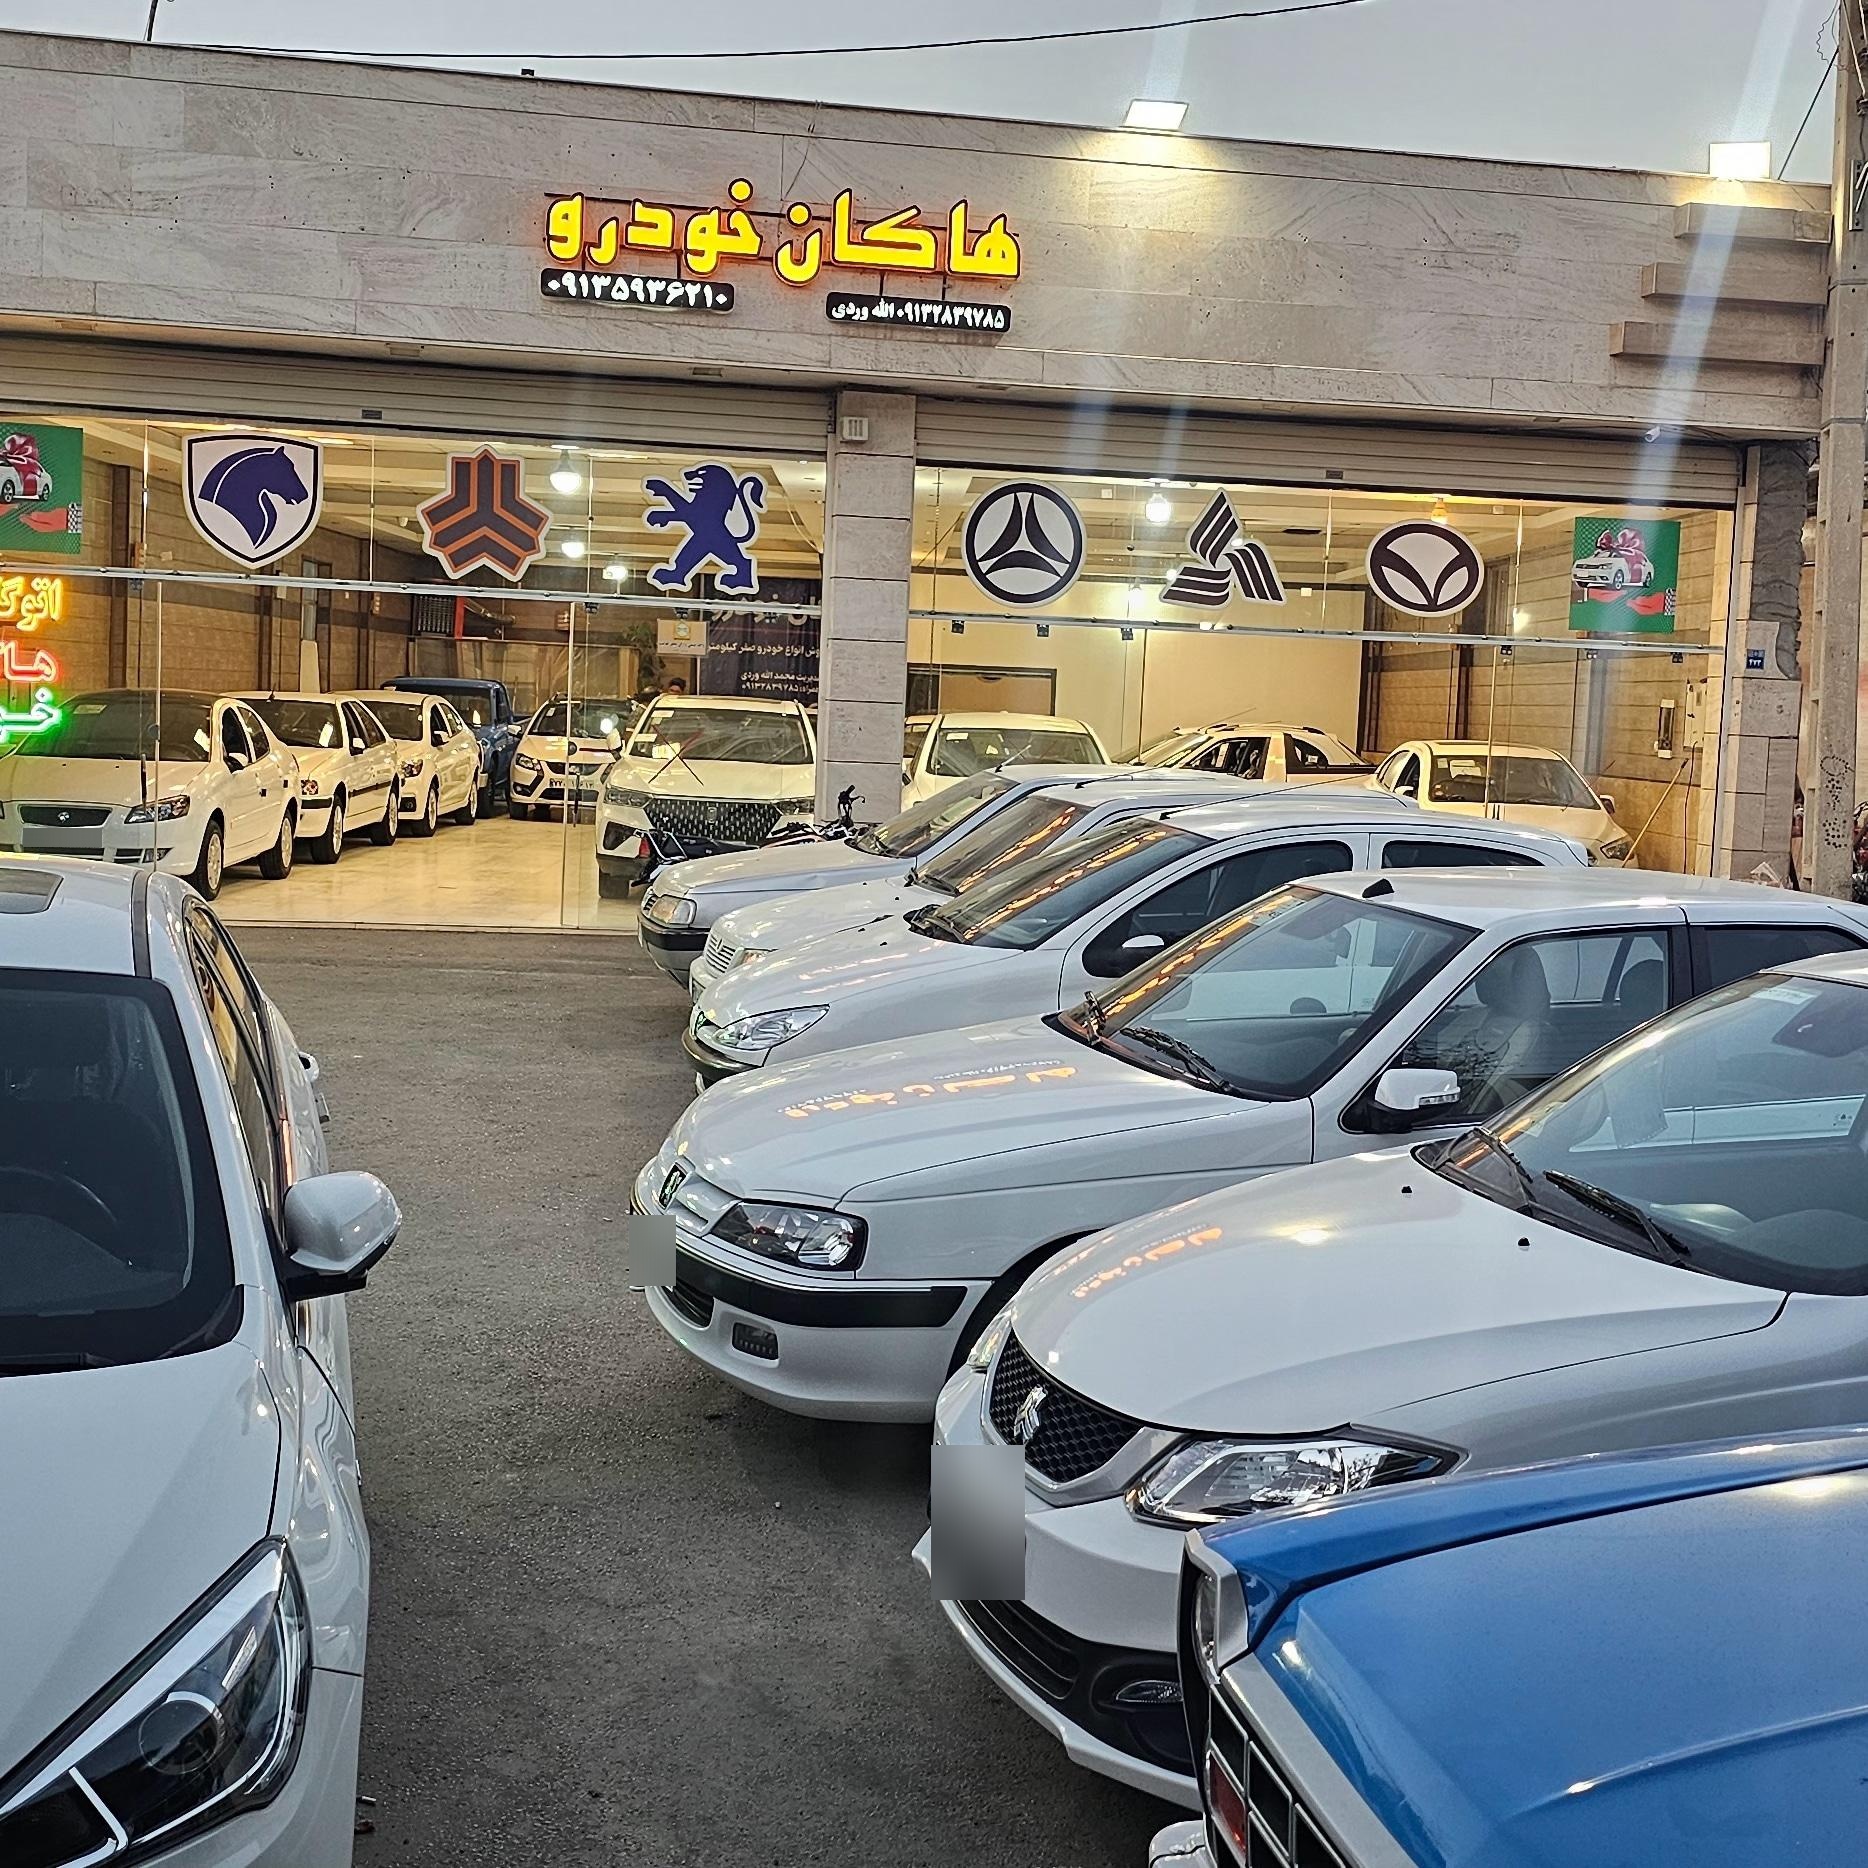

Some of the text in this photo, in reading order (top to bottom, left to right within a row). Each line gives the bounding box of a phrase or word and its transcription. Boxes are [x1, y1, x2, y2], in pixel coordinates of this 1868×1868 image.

[546, 177, 1020, 286] هاکان خودرو
[547, 271, 728, 308] ۰۹۱۳۵۹۳۶۲۱۰
[831, 301, 869, 321] وردی
[897, 301, 1005, 329] ۰۹۱۳۲۸۳۹۷۸۵
